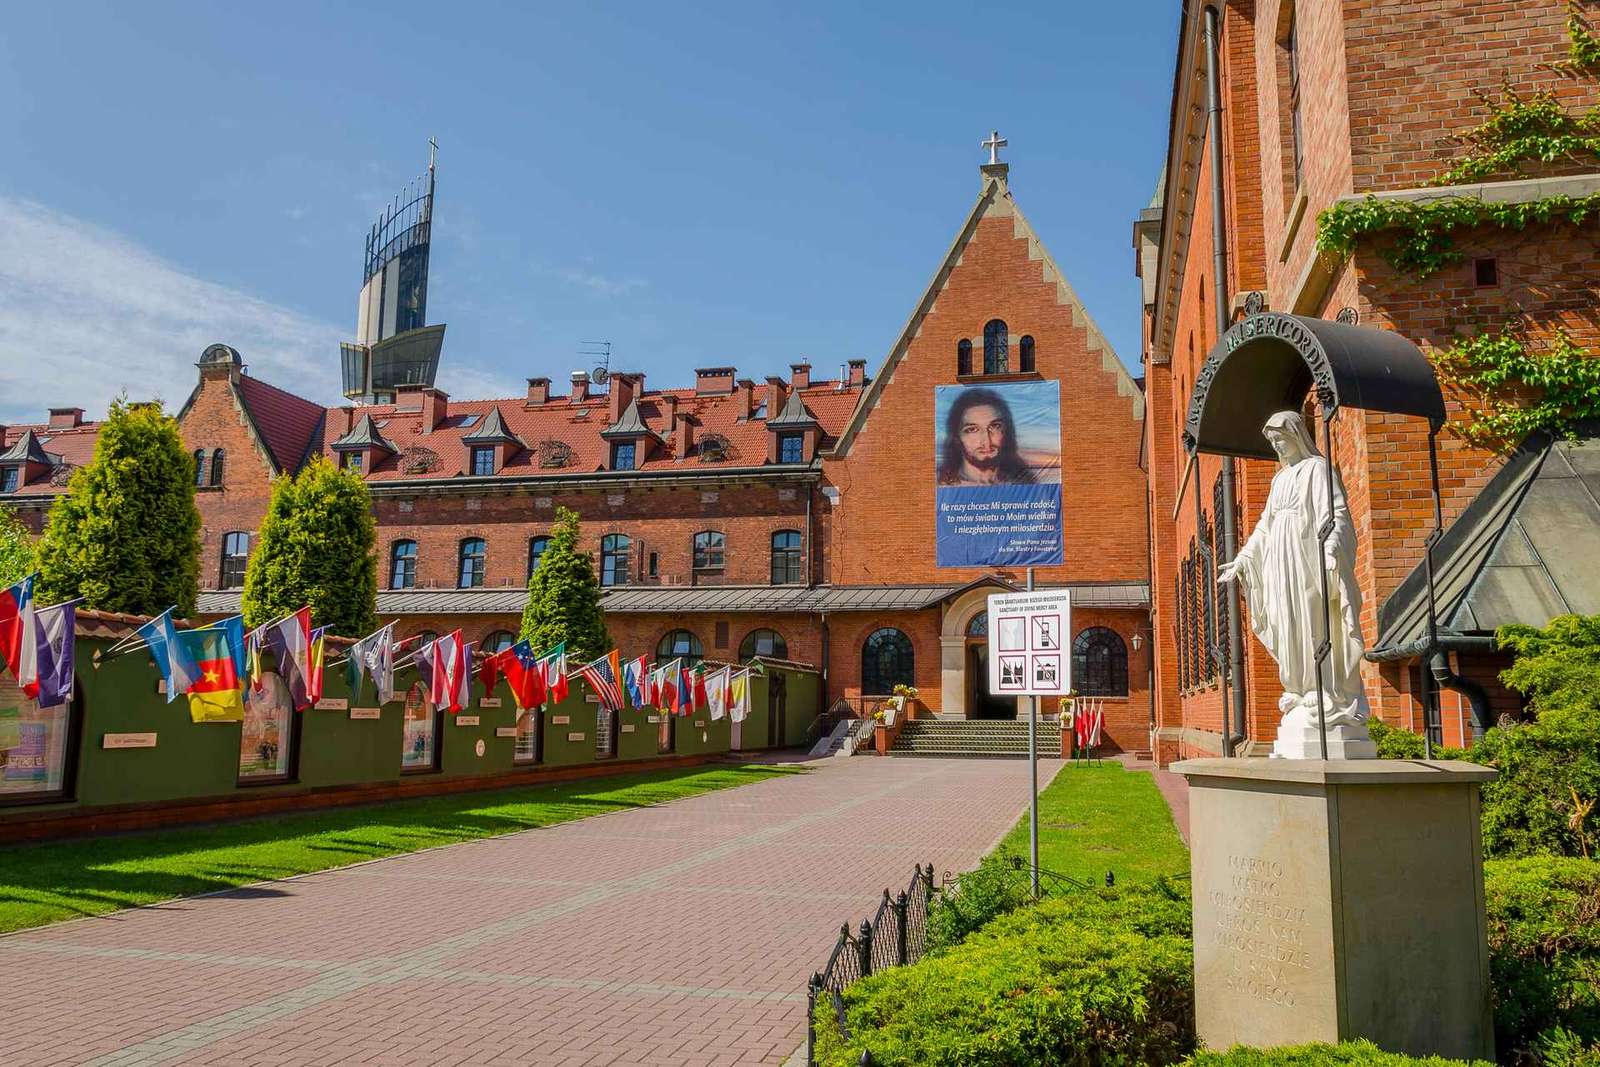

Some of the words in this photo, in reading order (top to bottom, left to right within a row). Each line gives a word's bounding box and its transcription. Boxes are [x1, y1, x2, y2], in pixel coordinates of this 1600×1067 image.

[941, 504, 950, 512] Ile
[951, 504, 966, 513] razy
[968, 502, 989, 511] chcesz
[991, 502, 1000, 510] Mi
[1001, 500, 1030, 512] sprawić
[956, 514, 973, 523] mów
[975, 514, 998, 522] światu
[1006, 513, 1027, 521] Moim
[1028, 512, 1056, 520] wielkim
[959, 524, 1009, 535] niezgłębionym
